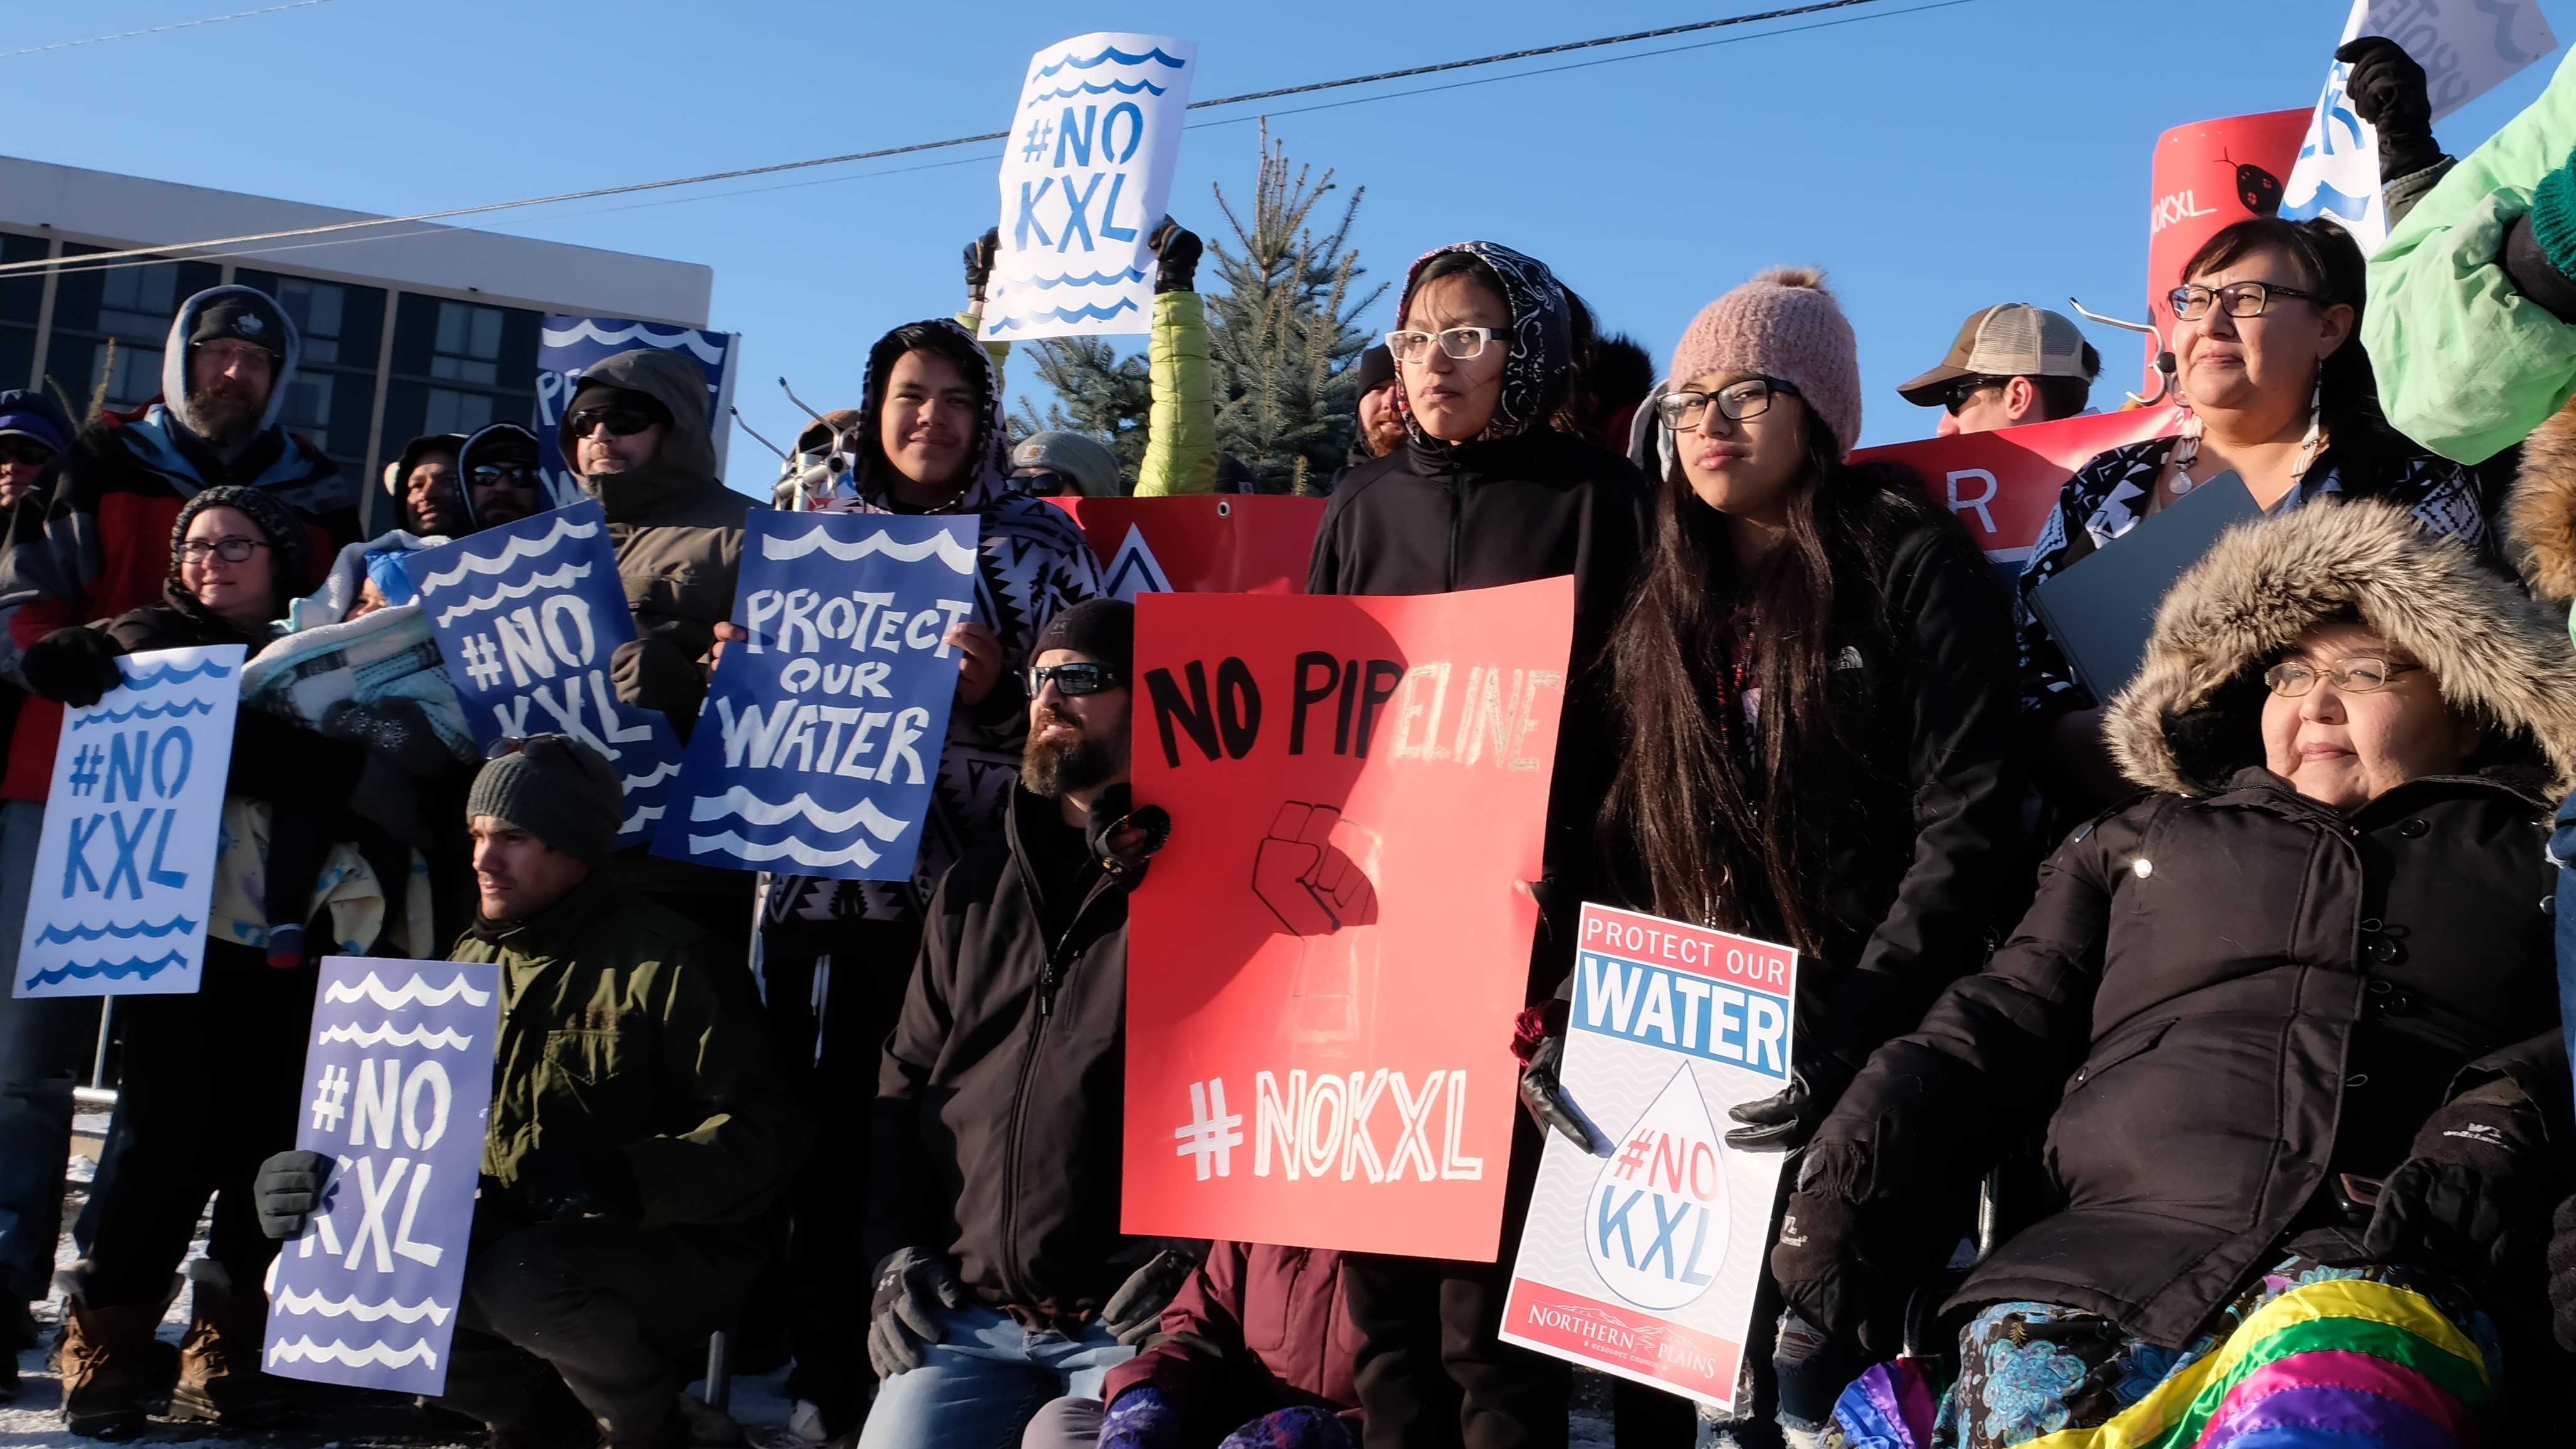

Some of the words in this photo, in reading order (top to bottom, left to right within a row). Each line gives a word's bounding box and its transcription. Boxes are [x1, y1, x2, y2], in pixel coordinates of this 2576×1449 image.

[1022, 101, 1144, 169] #NO
[1015, 173, 1137, 253] KXL
[2152, 189, 2218, 233] OKXL
[461, 595, 595, 692] #NO
[746, 588, 973, 658] PROTECT
[780, 658, 892, 699] OUR
[1143, 657, 1261, 768] NO
[1288, 651, 1561, 772] PIPELINE
[70, 725, 194, 804] #NO
[715, 695, 929, 784] WATER
[61, 808, 189, 901] KXL
[1587, 917, 1715, 967] PROTECT
[1725, 948, 1786, 986] OUR
[1583, 957, 1786, 1074] WATER
[311, 1059, 453, 1151] #NO
[1613, 1127, 1719, 1202] #NO
[1599, 1185, 1718, 1287] KXL
[1528, 1304, 1635, 1349] NORTHERN
[1657, 1342, 1717, 1379] PLAINS
